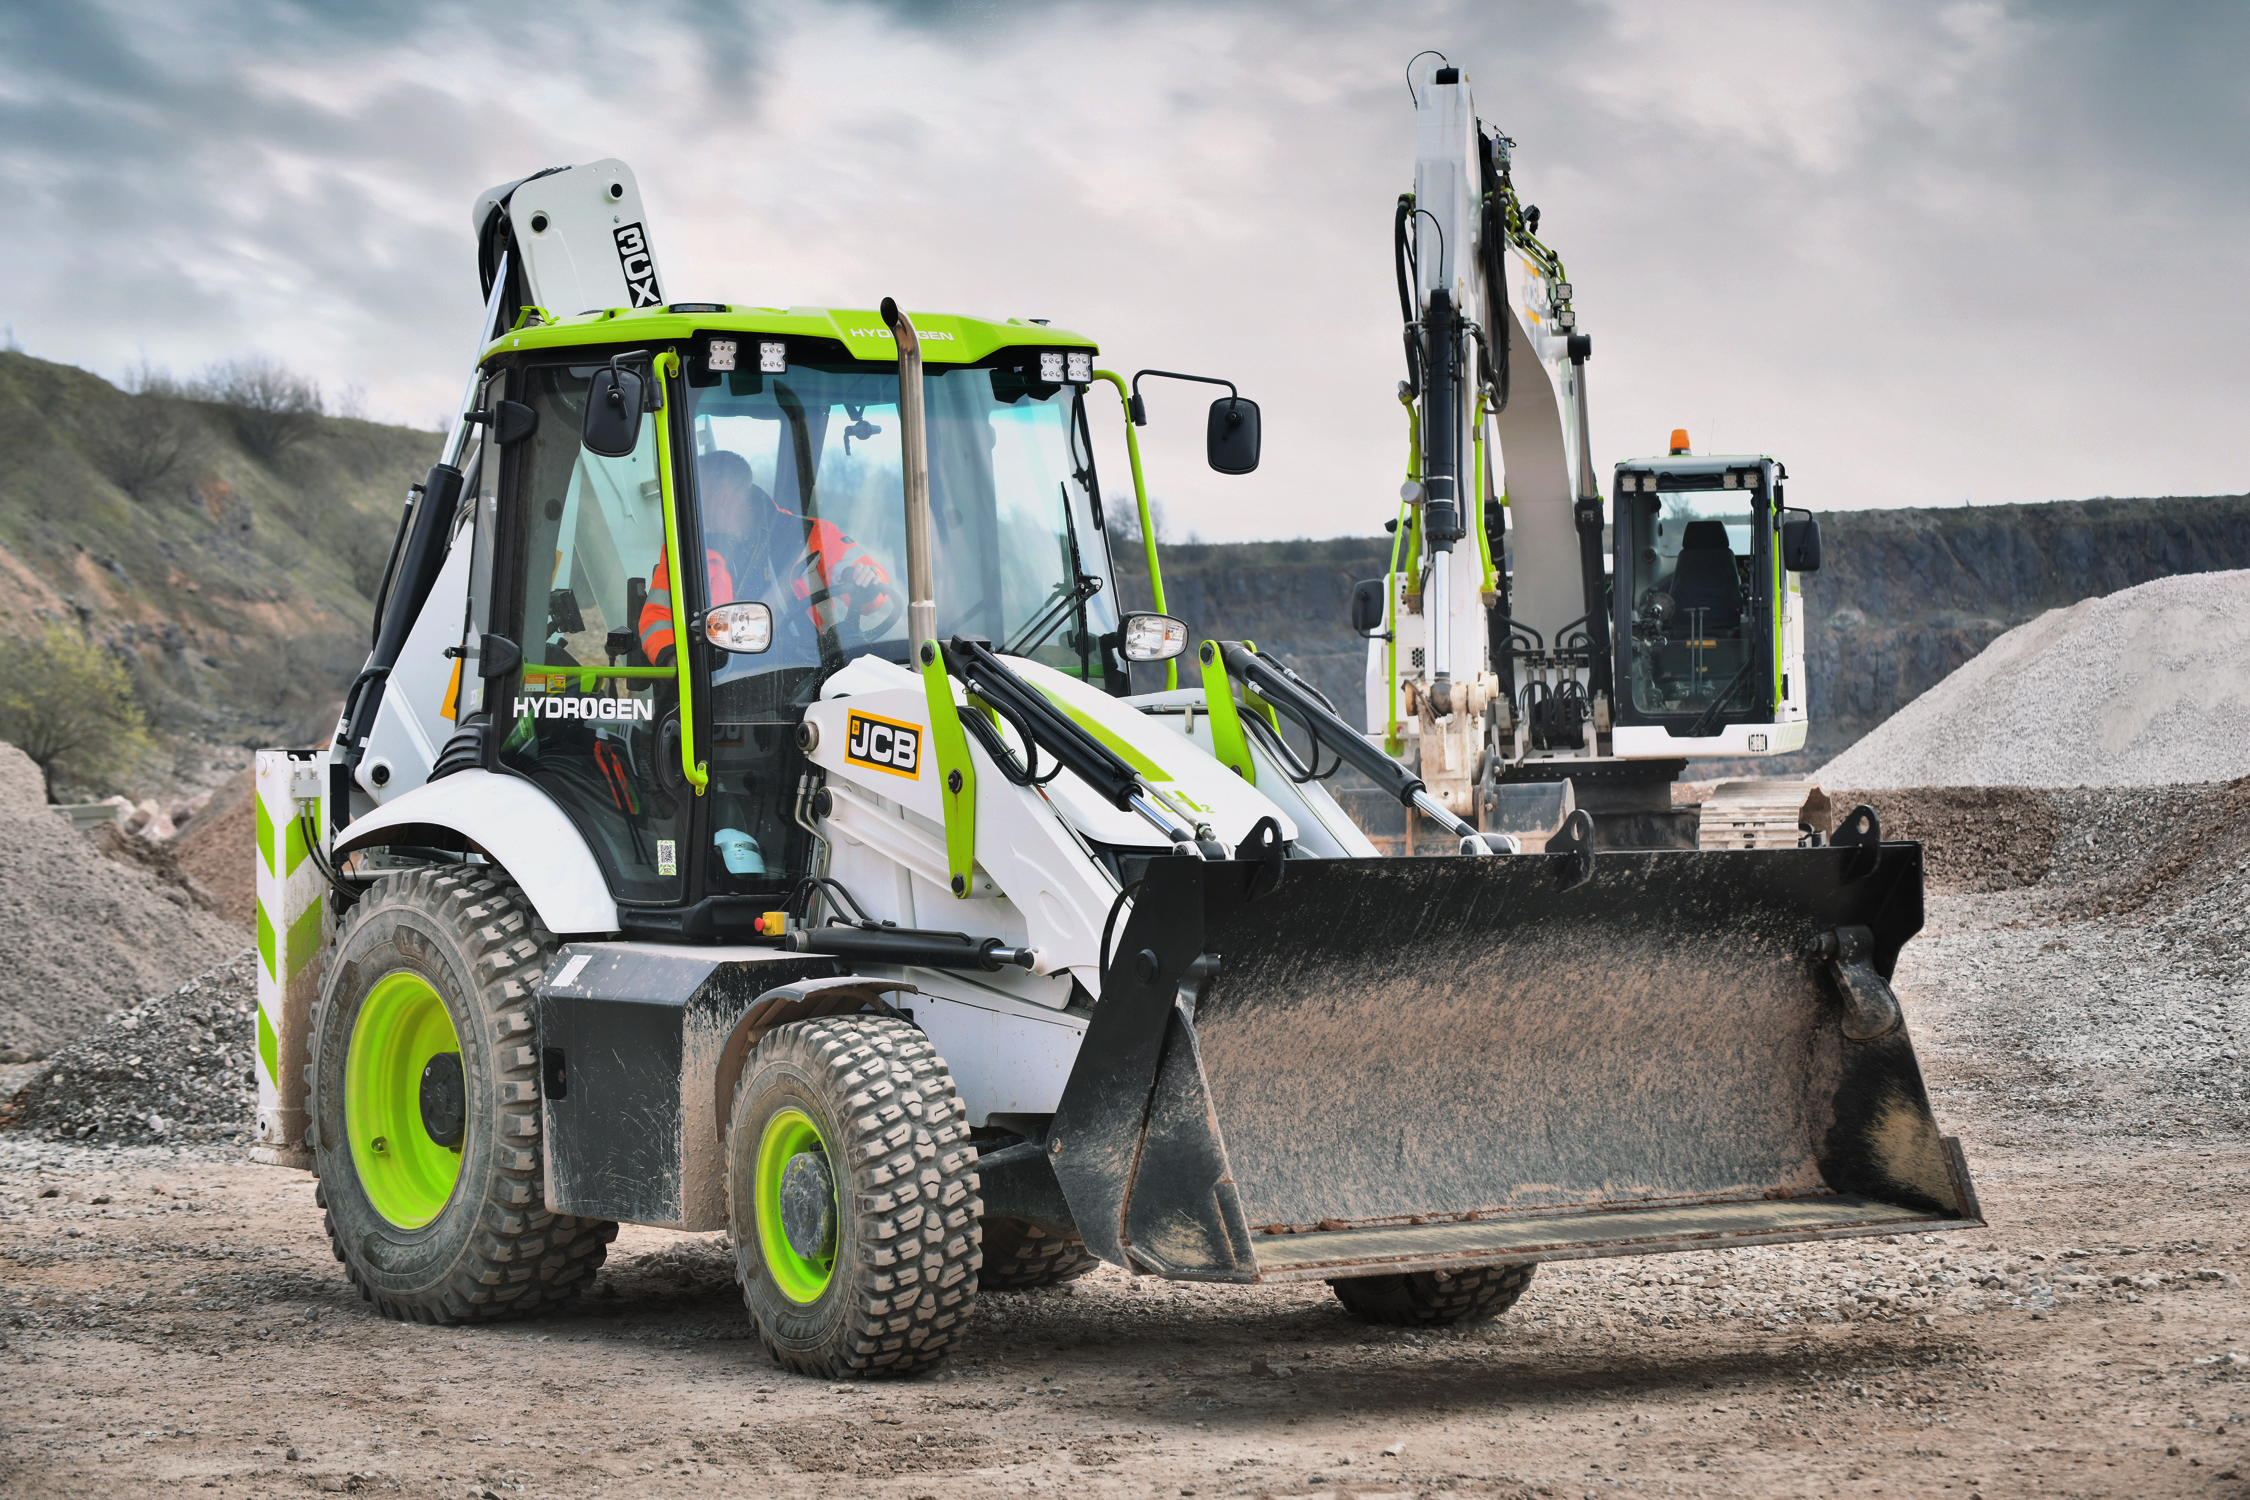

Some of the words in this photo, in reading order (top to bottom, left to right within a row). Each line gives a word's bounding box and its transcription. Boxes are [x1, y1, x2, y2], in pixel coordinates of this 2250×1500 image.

[617, 227, 661, 308] 3CX
[850, 328, 954, 341] HYDGEN
[513, 697, 653, 720] HYDROGEN
[850, 722, 916, 768] JCB
